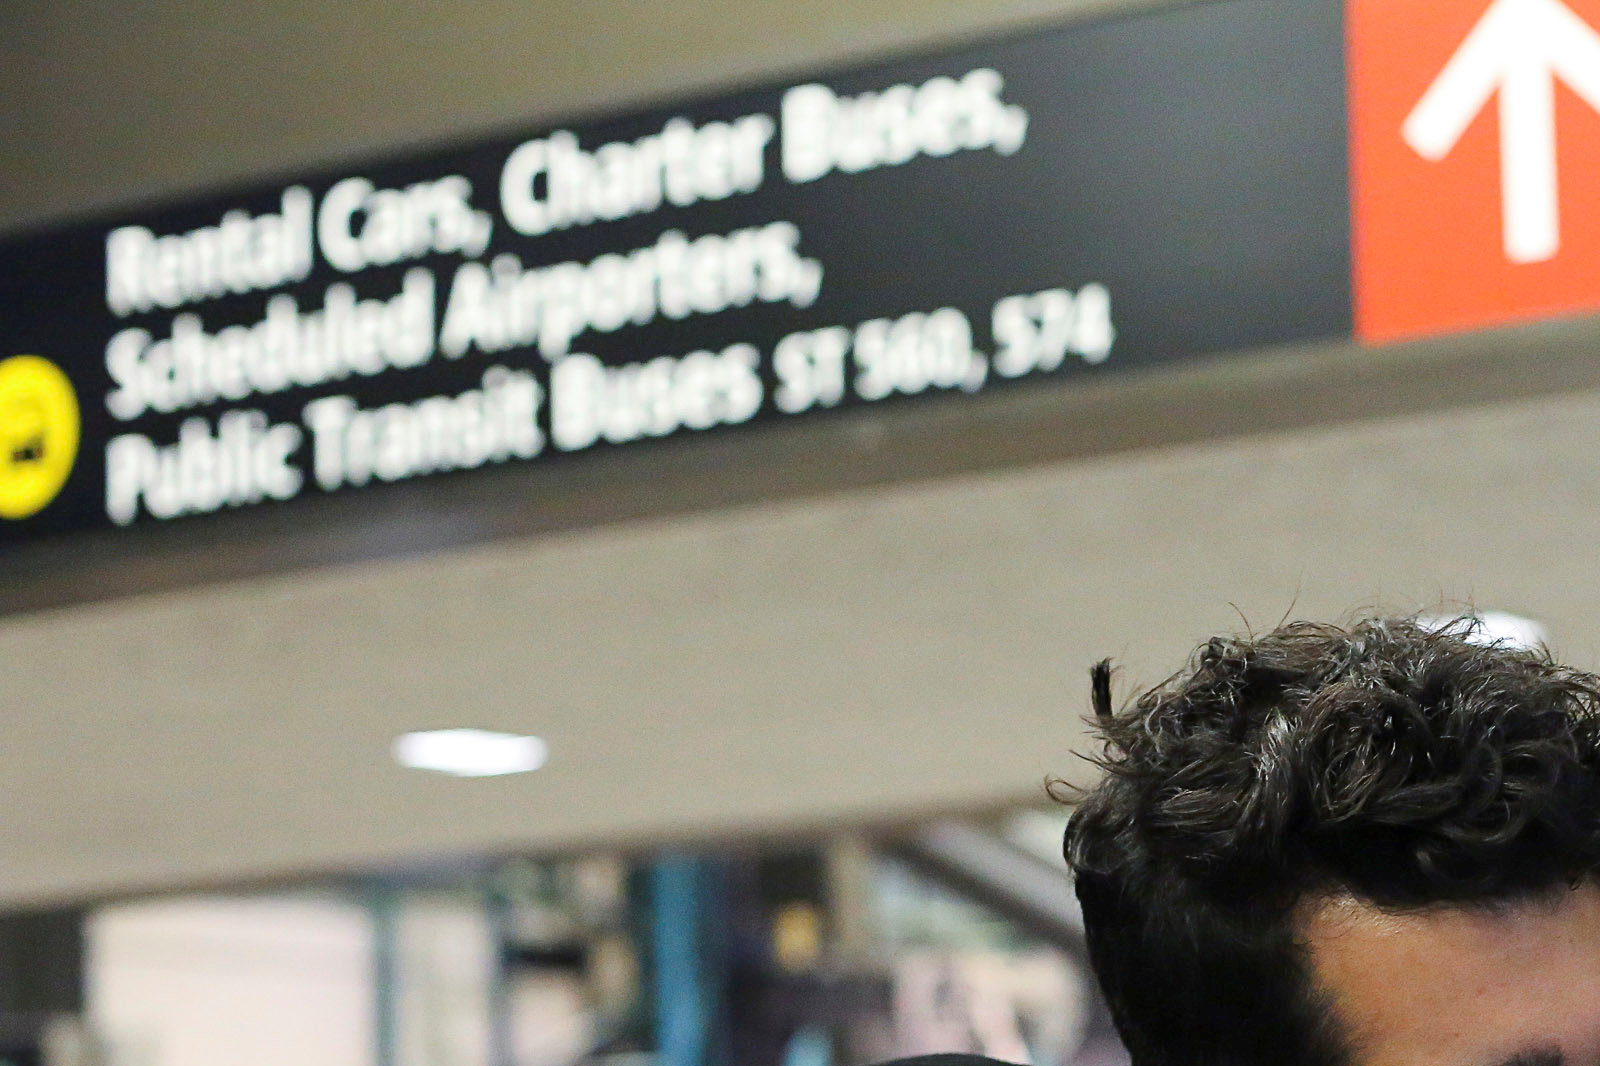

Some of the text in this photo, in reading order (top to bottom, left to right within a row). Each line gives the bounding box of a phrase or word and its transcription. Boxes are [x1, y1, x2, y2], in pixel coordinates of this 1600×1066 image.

[106, 68, 1028, 314] Rental Cars, Charter Buses,
[105, 221, 822, 420] Scheduled Airporters,
[106, 282, 1113, 526] Public Transit Buses ST 560, 574
